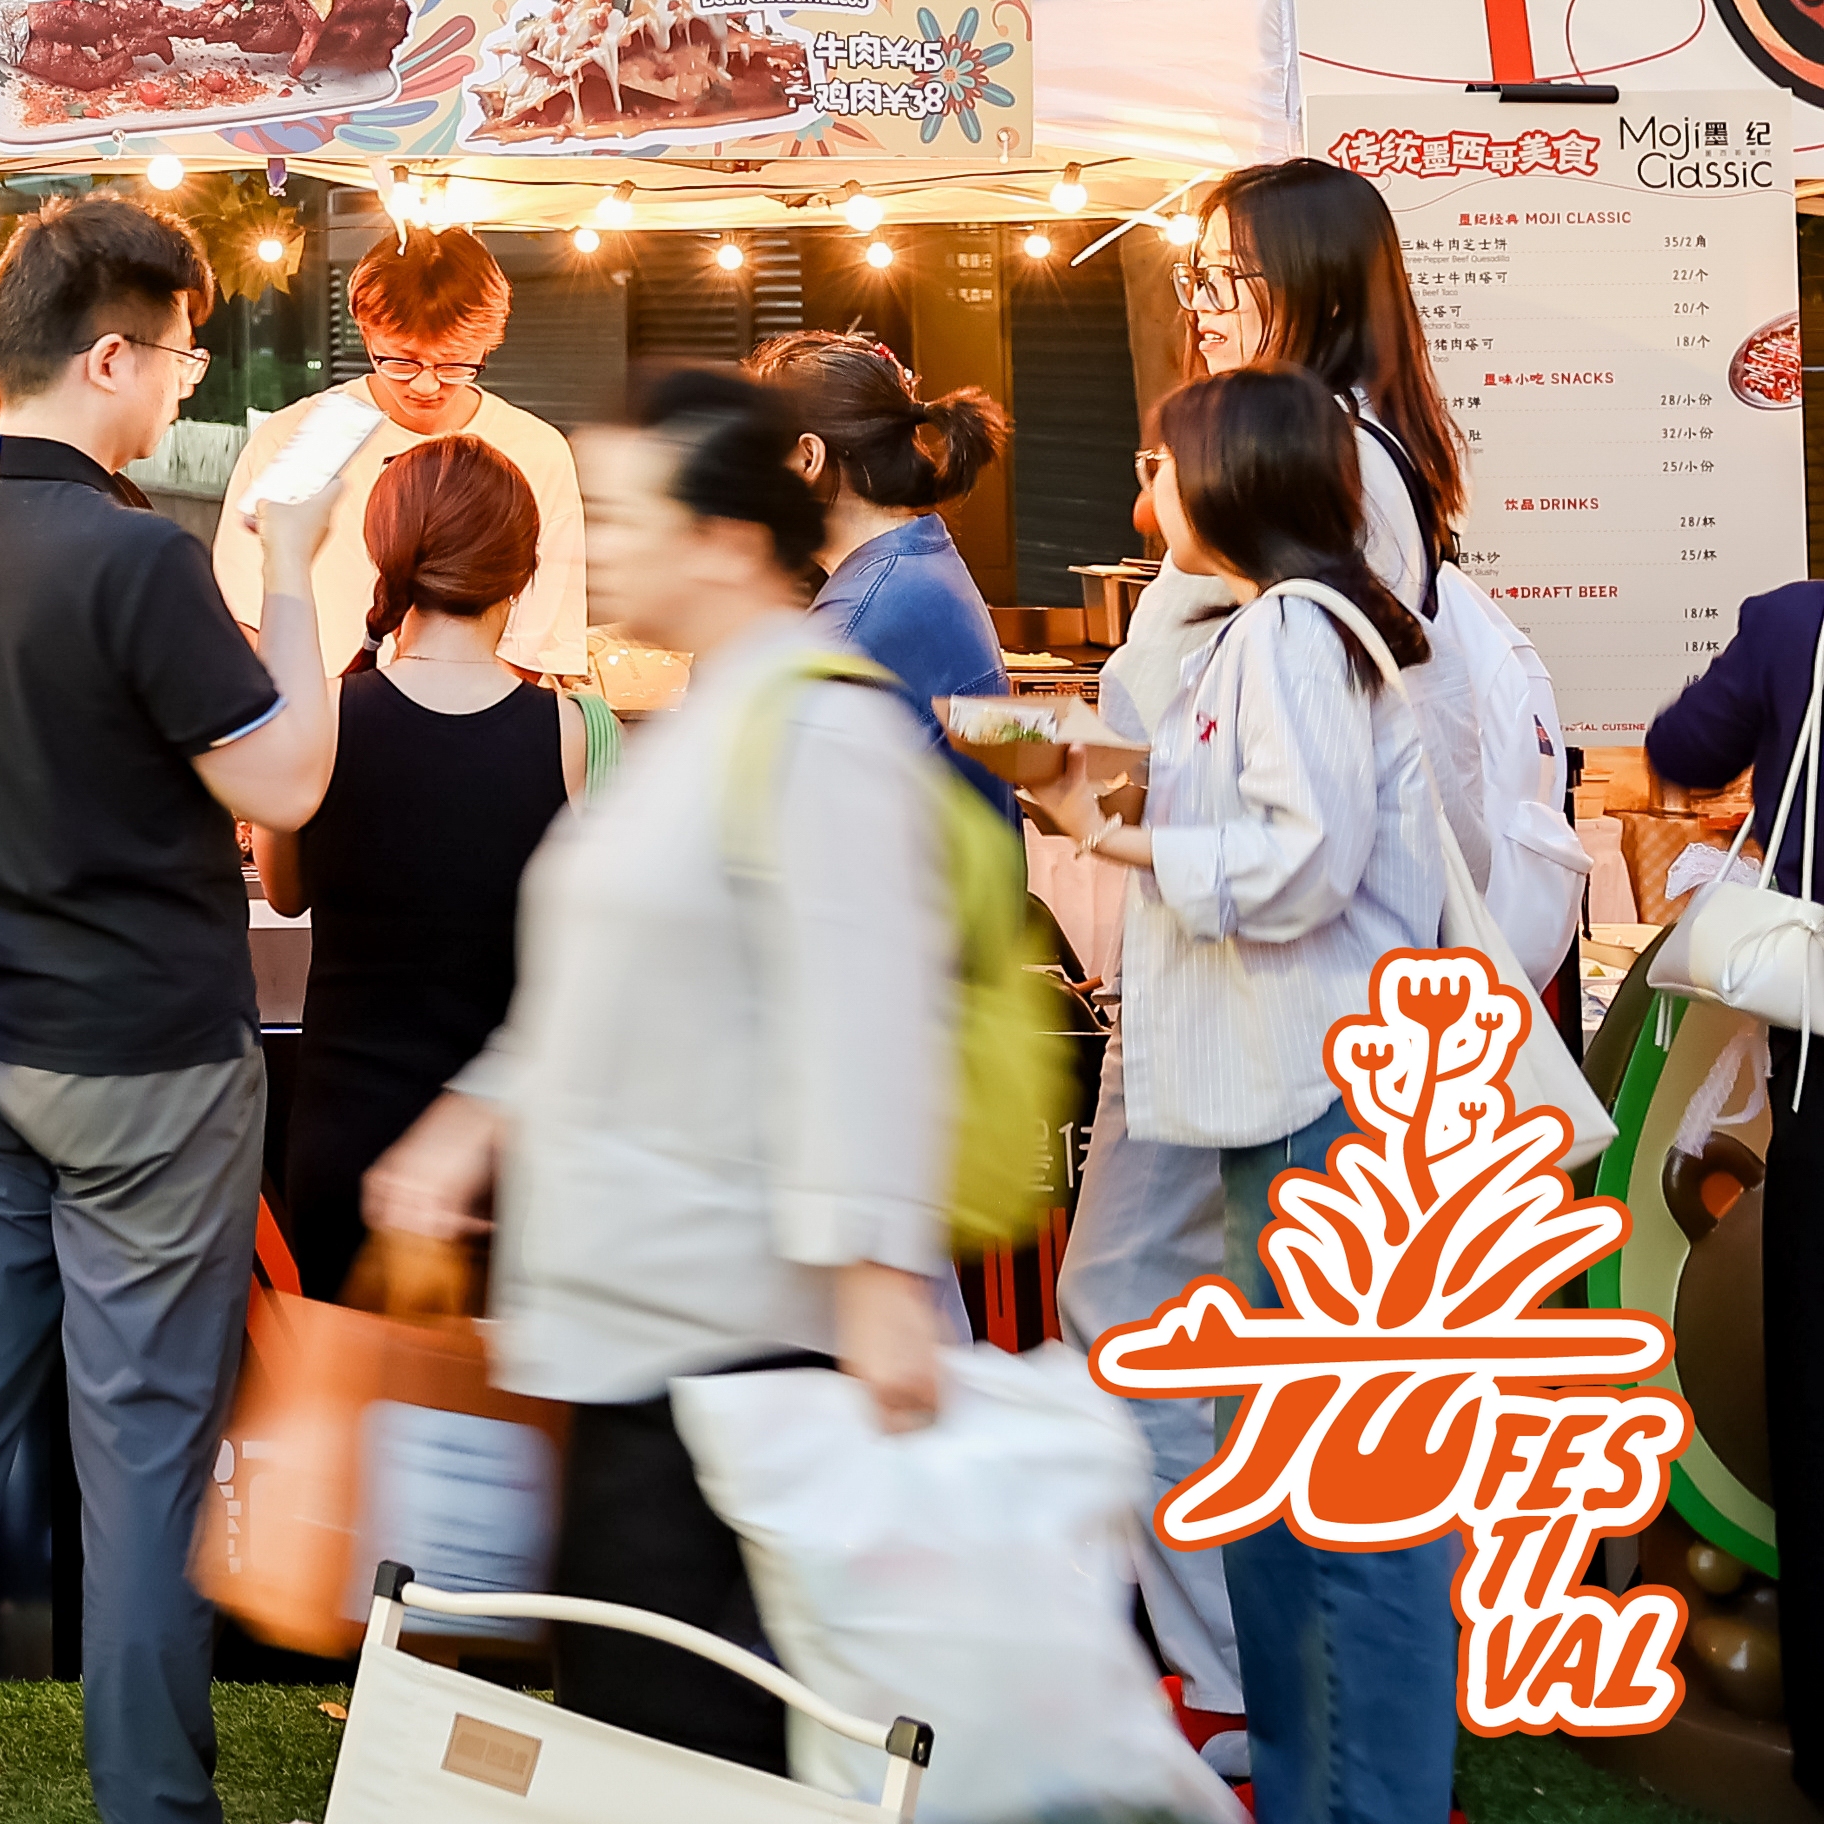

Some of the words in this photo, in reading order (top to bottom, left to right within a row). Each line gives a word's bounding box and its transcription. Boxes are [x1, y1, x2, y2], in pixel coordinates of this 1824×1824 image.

[814, 32, 944, 72] 牛肉¥45
[814, 78, 946, 116] 鸡肉¥38
[1328, 128, 1601, 178] 传统墨西哥美食
[1637, 152, 1773, 189] Classic
[1525, 212, 1561, 225] MOJI
[1566, 211, 1632, 224] CLASSIC
[1672, 269, 1708, 282] 22/个
[1418, 305, 1462, 318] 夫塔可
[1673, 302, 1709, 315] 20/个
[1676, 336, 1710, 349] 18/个
[1551, 372, 1614, 384] SNACKS
[1660, 393, 1713, 406] 28/小份
[1662, 428, 1714, 440] 32/小份
[1662, 460, 1714, 473] 25/小份
[1504, 498, 1534, 511] 饮品
[1540, 497, 1599, 510] DRINKS
[1680, 516, 1716, 528] 28/杯
[1681, 549, 1717, 561] 25/杯
[1521, 586, 1572, 598] DRAFT
[1578, 586, 1618, 598] BEER
[1683, 608, 1718, 619] 18/杯
[1602, 723, 1645, 731] CUISINE
